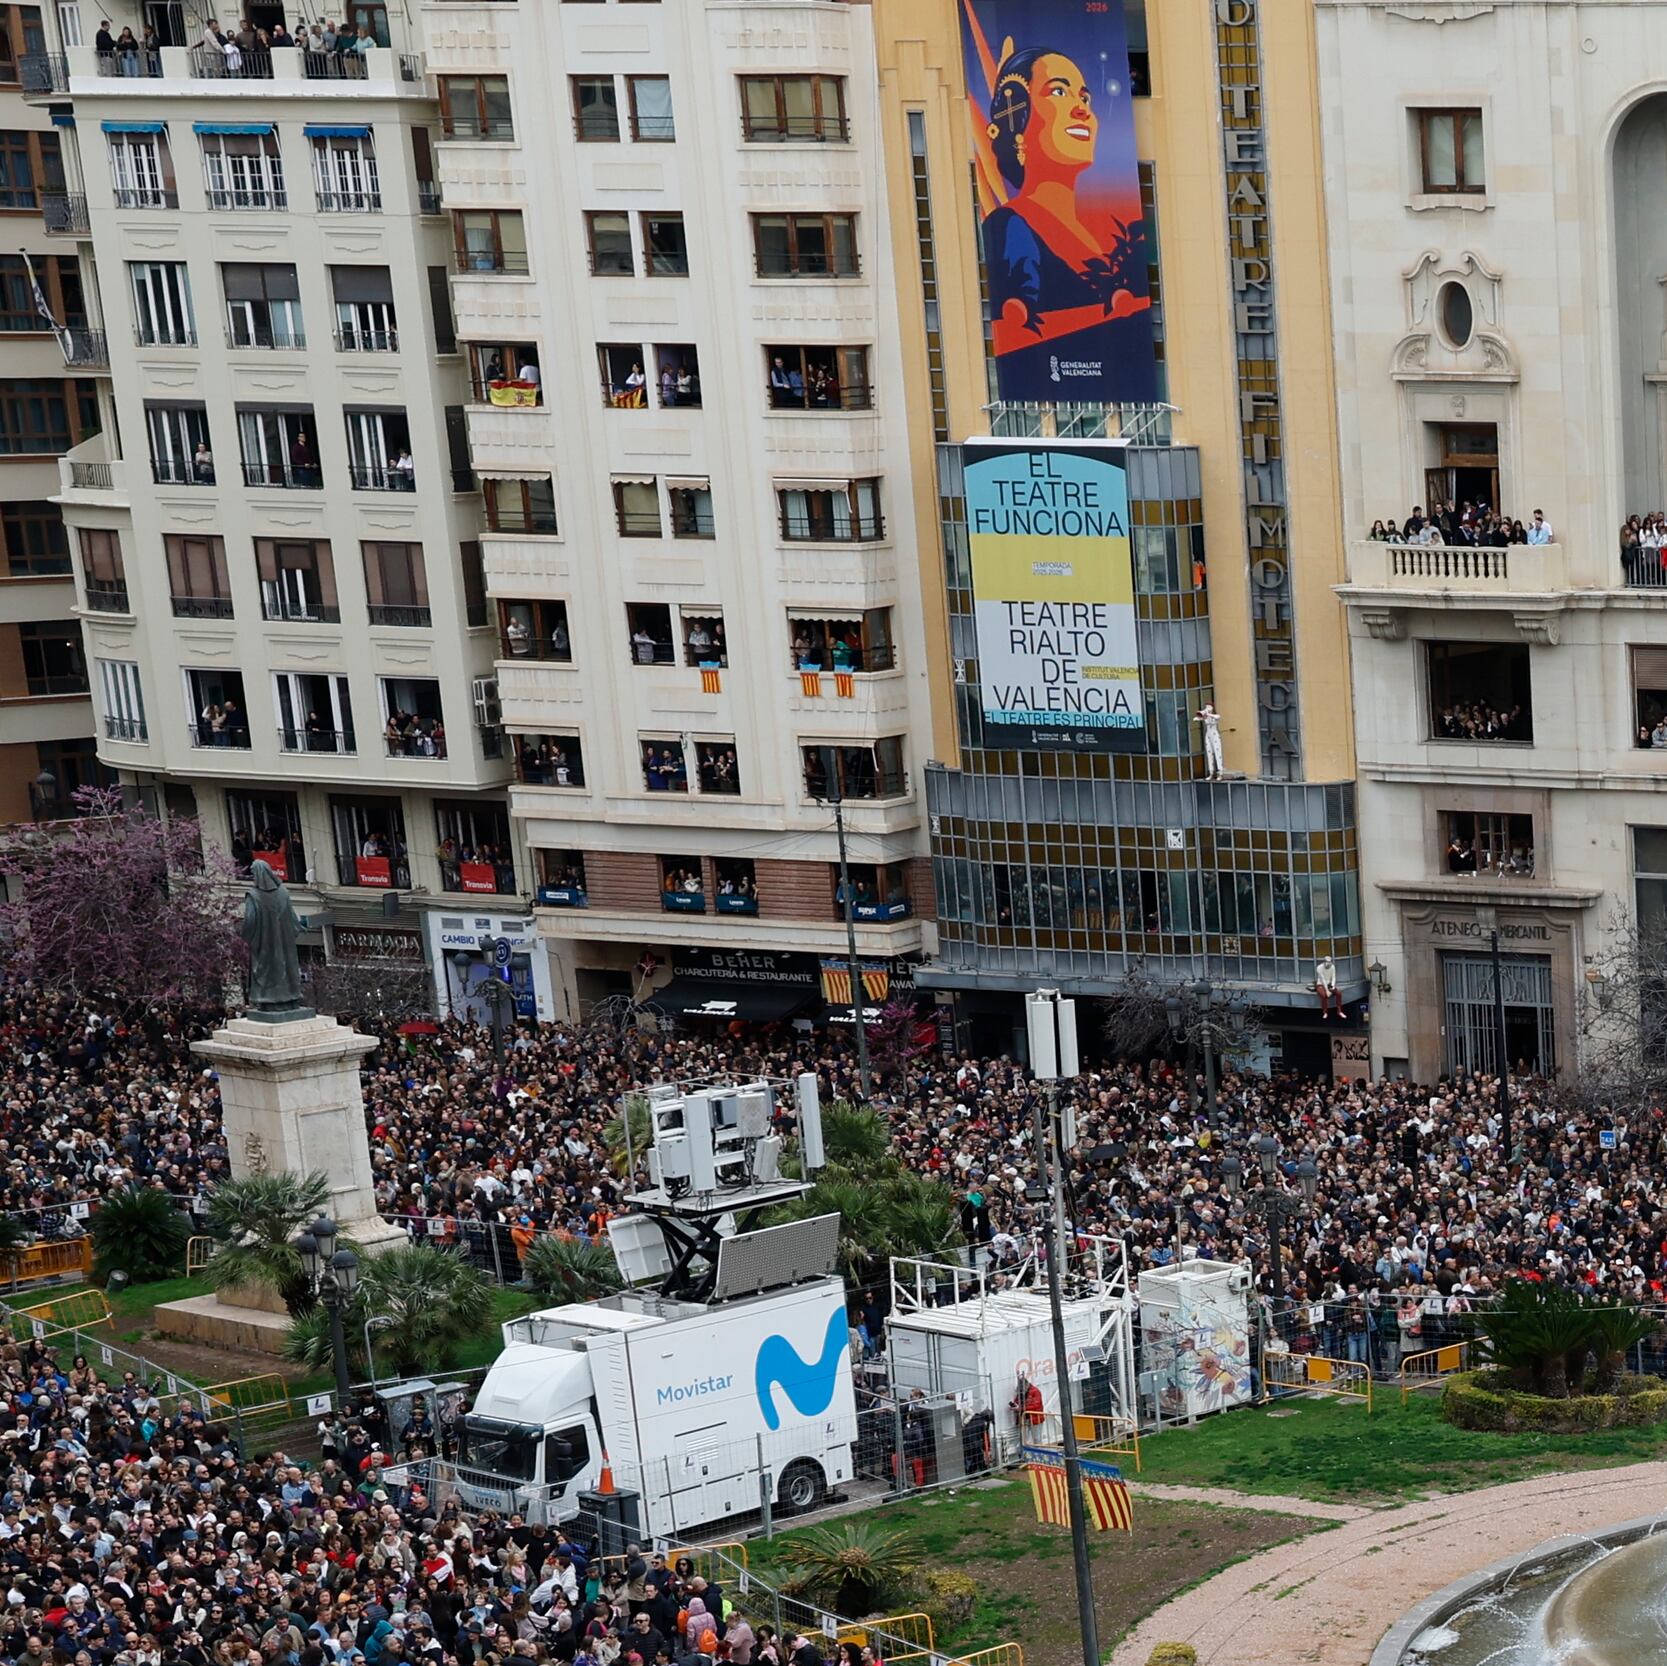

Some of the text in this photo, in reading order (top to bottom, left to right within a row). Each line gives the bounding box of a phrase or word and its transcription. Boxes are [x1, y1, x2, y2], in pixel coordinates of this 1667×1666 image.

[1029, 451, 1062, 478] EL
[992, 480, 1099, 508] TEATRE
[975, 509, 1125, 537] FUNCIONA
[1241, 391, 1296, 754] FILMOTECA
[1002, 601, 1108, 628] TEATRE
[1010, 629, 1106, 657] RIALTO
[1042, 658, 1078, 684] DE
[1002, 712, 1050, 725] TEATRE
[1073, 713, 1143, 729] PRINCIPAL
[338, 932, 420, 951] FARMACIA
[441, 934, 475, 945] CAMBIO
[1431, 921, 1482, 937] ATENEO
[673, 966, 738, 979] CHARCUTERÍA
[747, 971, 814, 984] RESTAURANTE
[712, 954, 776, 970] BEHER
[656, 1371, 734, 1406] Movistar
